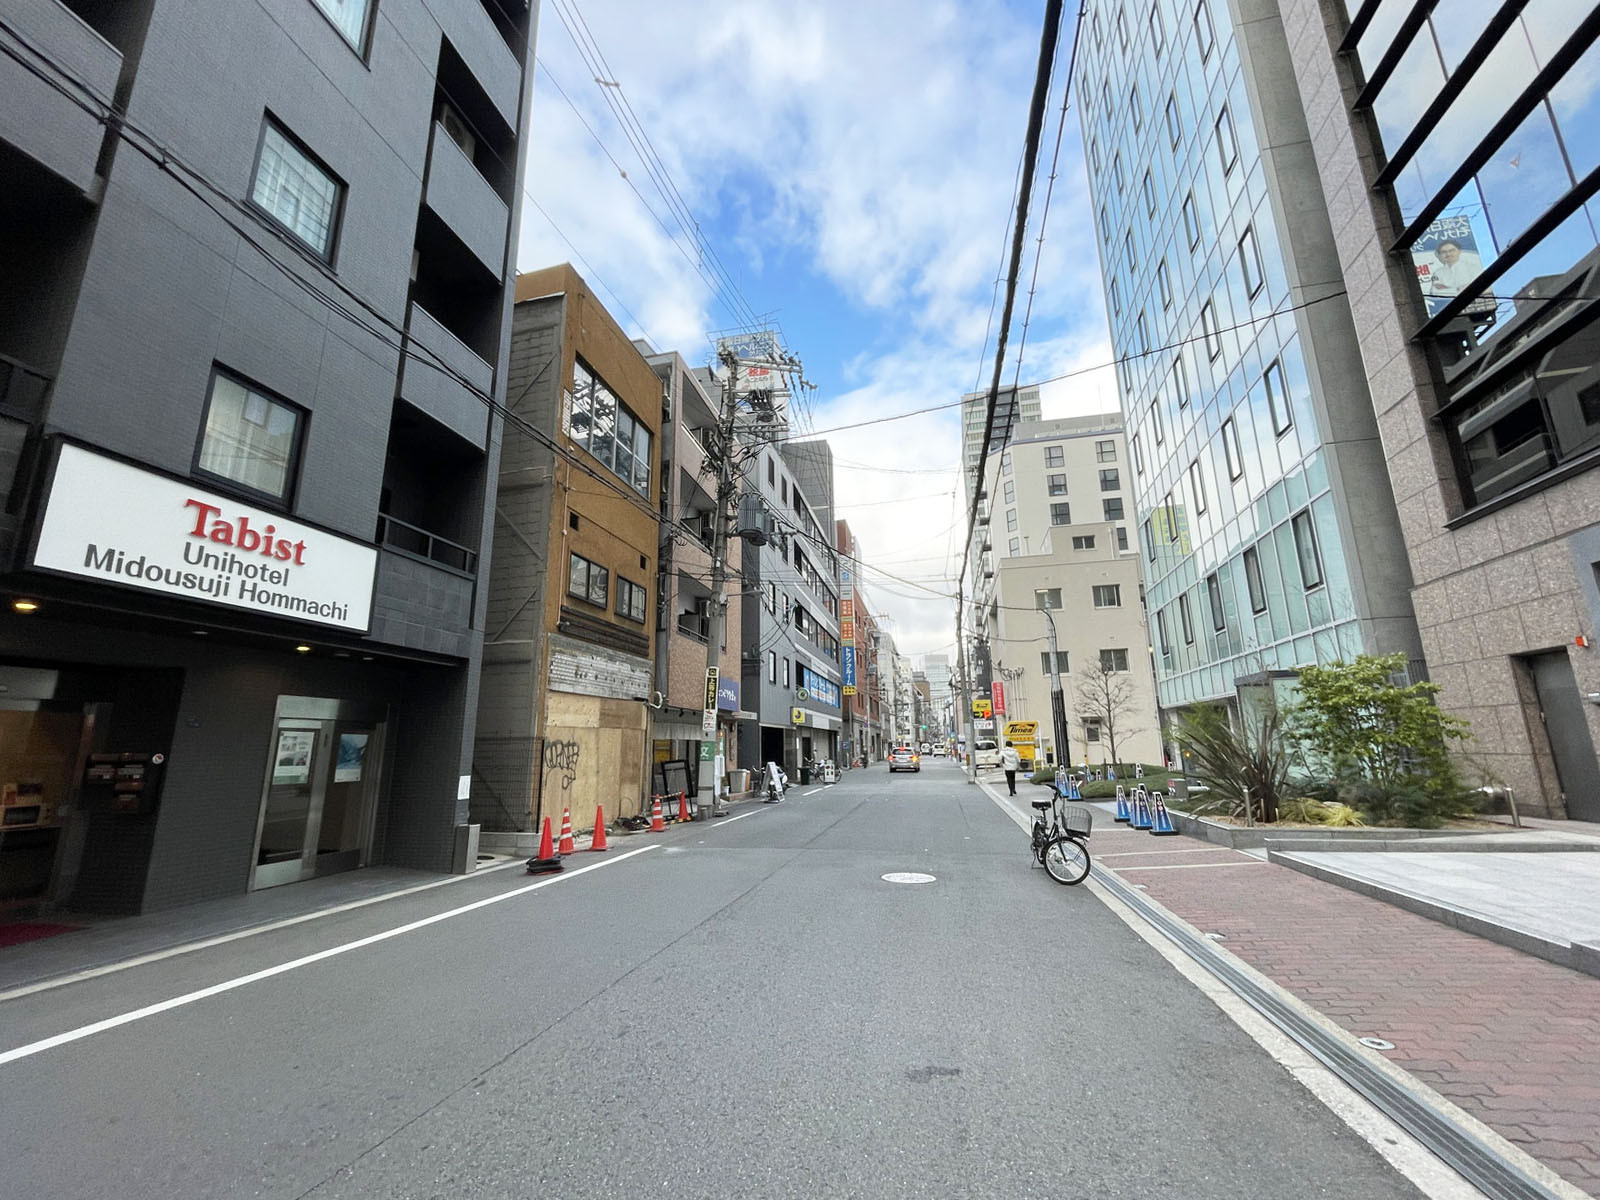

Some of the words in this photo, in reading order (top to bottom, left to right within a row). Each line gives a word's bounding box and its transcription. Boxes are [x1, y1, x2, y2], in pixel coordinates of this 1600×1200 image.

[183, 498, 307, 566] Tabist
[84, 543, 233, 598] Midousuji
[237, 580, 348, 622] Hommachi
[182, 541, 290, 587] Unihotel
[845, 647, 853, 686] トランクルーム
[1009, 723, 1036, 734] Times
